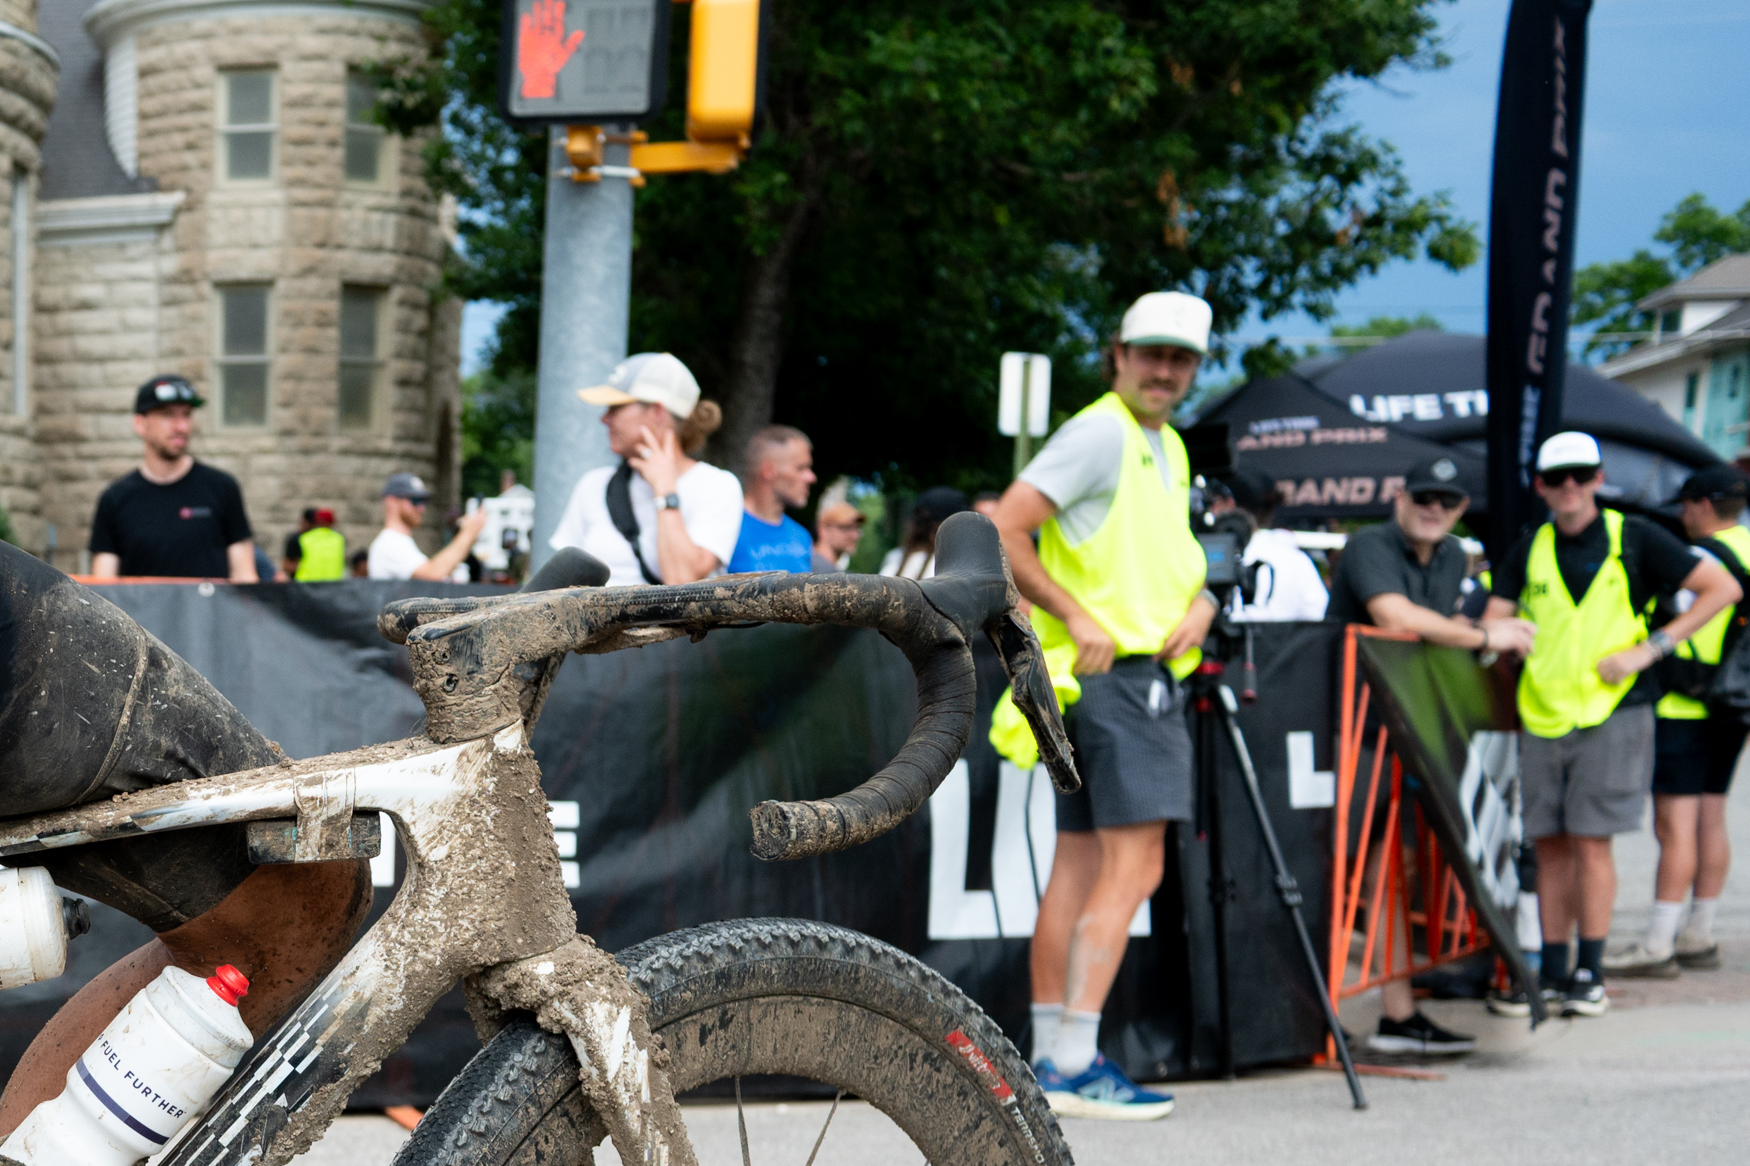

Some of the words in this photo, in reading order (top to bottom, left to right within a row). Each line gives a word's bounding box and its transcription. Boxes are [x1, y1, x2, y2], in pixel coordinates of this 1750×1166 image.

[1350, 394, 1444, 422] LIFE
[1442, 389, 1489, 418] TI
[1236, 430, 1307, 450] AND
[100, 1040, 121, 1071] FUEL
[124, 1070, 185, 1119] FURTHER
